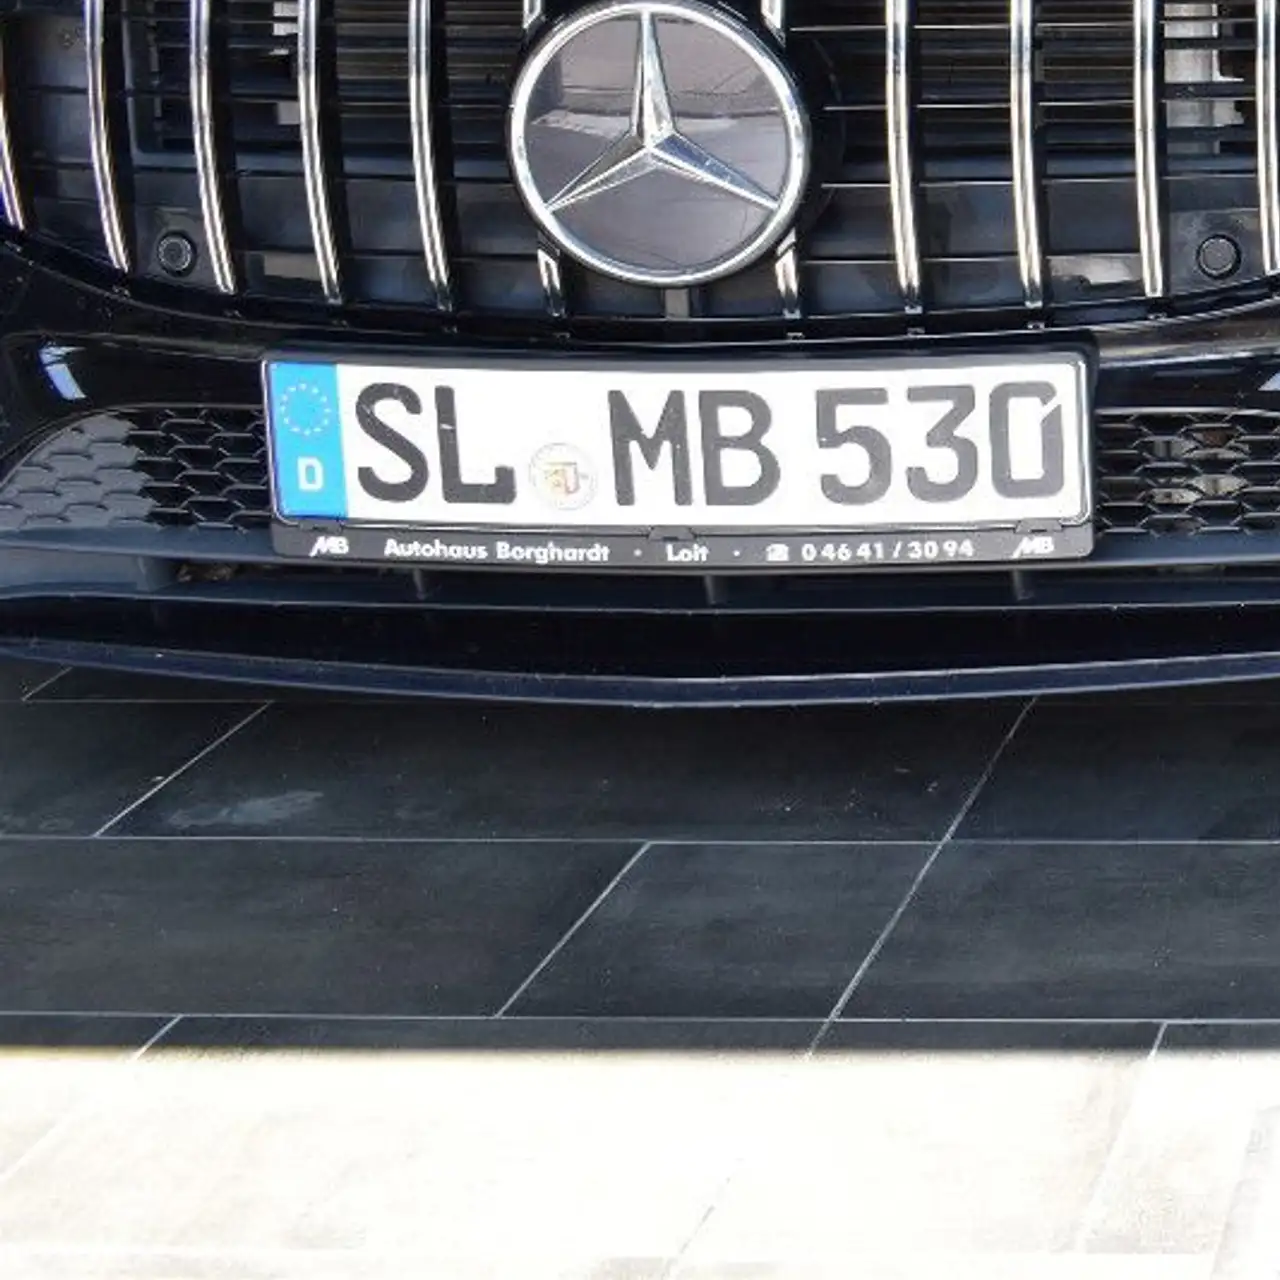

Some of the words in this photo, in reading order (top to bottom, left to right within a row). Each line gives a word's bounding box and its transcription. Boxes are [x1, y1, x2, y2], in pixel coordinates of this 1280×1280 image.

[355, 382, 517, 504] SL
[608, 390, 781, 506] MB
[816, 381, 1065, 506] 530
[297, 456, 323, 492] D
[384, 538, 487, 559] Autohaus
[496, 542, 610, 563] Borghardt
[666, 543, 709, 561] Loit
